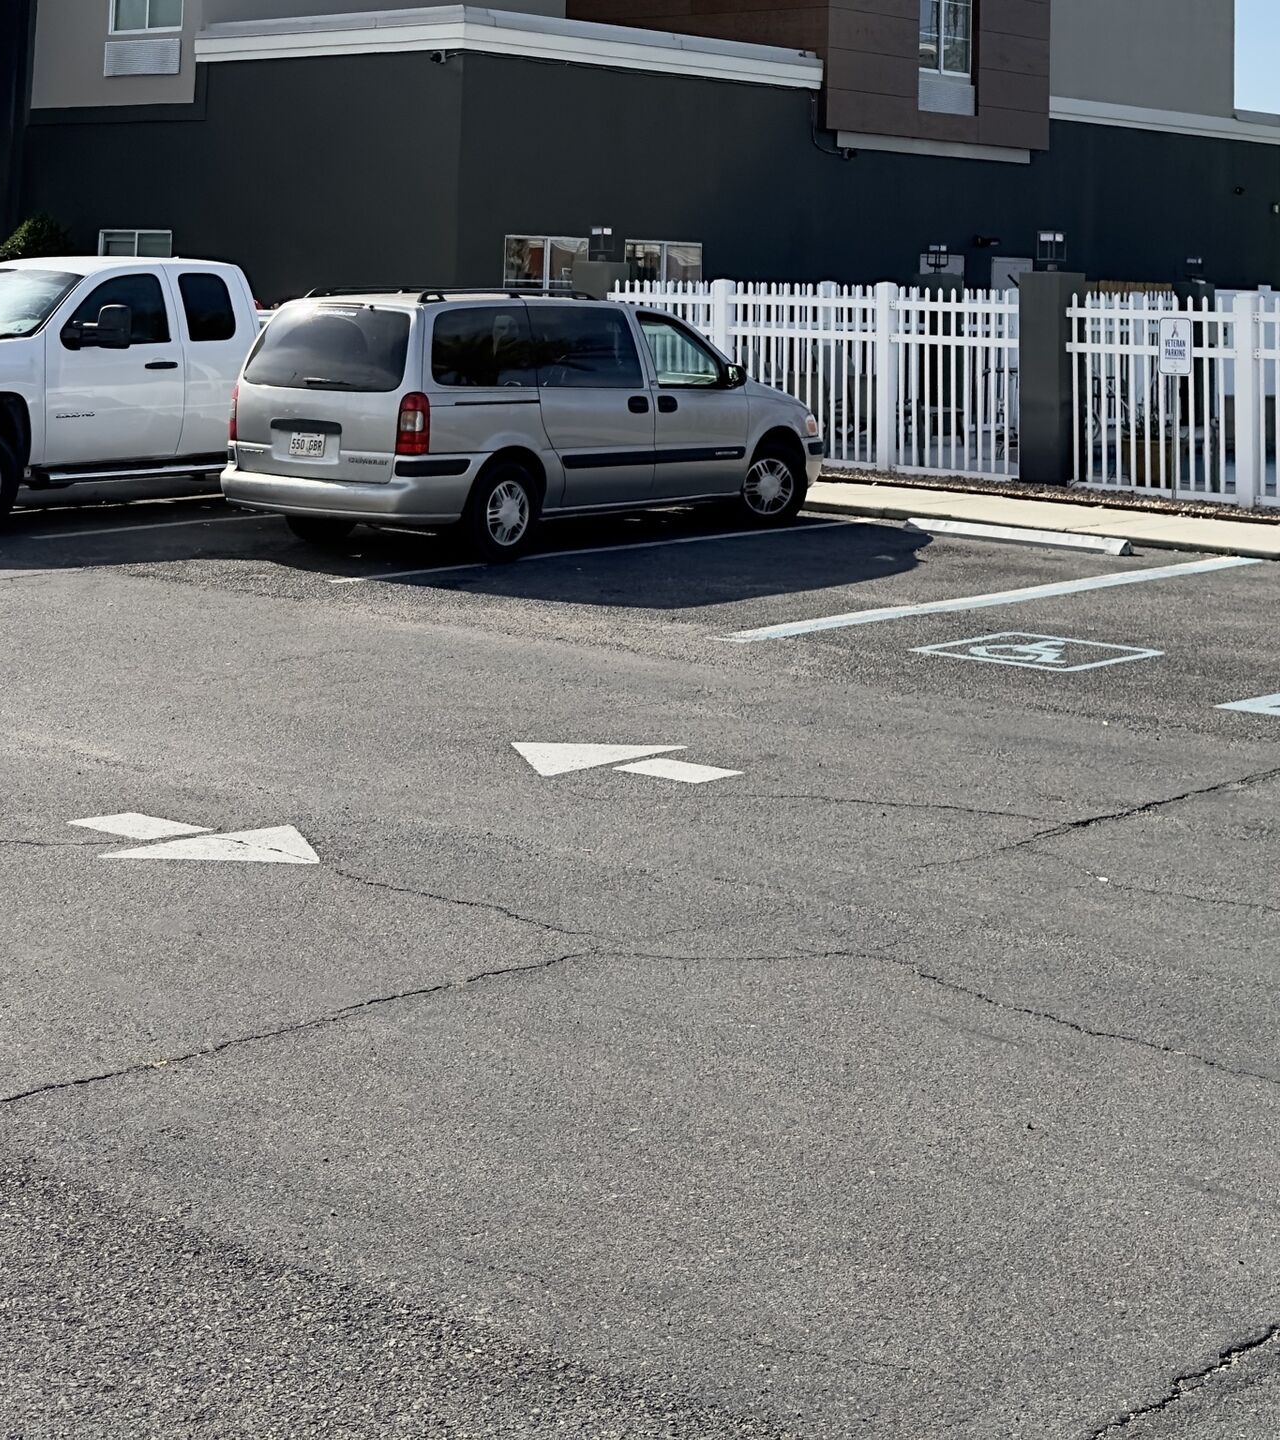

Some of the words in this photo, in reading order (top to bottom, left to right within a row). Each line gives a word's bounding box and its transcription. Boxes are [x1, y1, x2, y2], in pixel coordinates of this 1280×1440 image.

[1165, 339, 1186, 348] VETERAN
[1165, 349, 1186, 357] PARKING
[291, 438, 305, 450] 550
[309, 439, 323, 452] GBR
